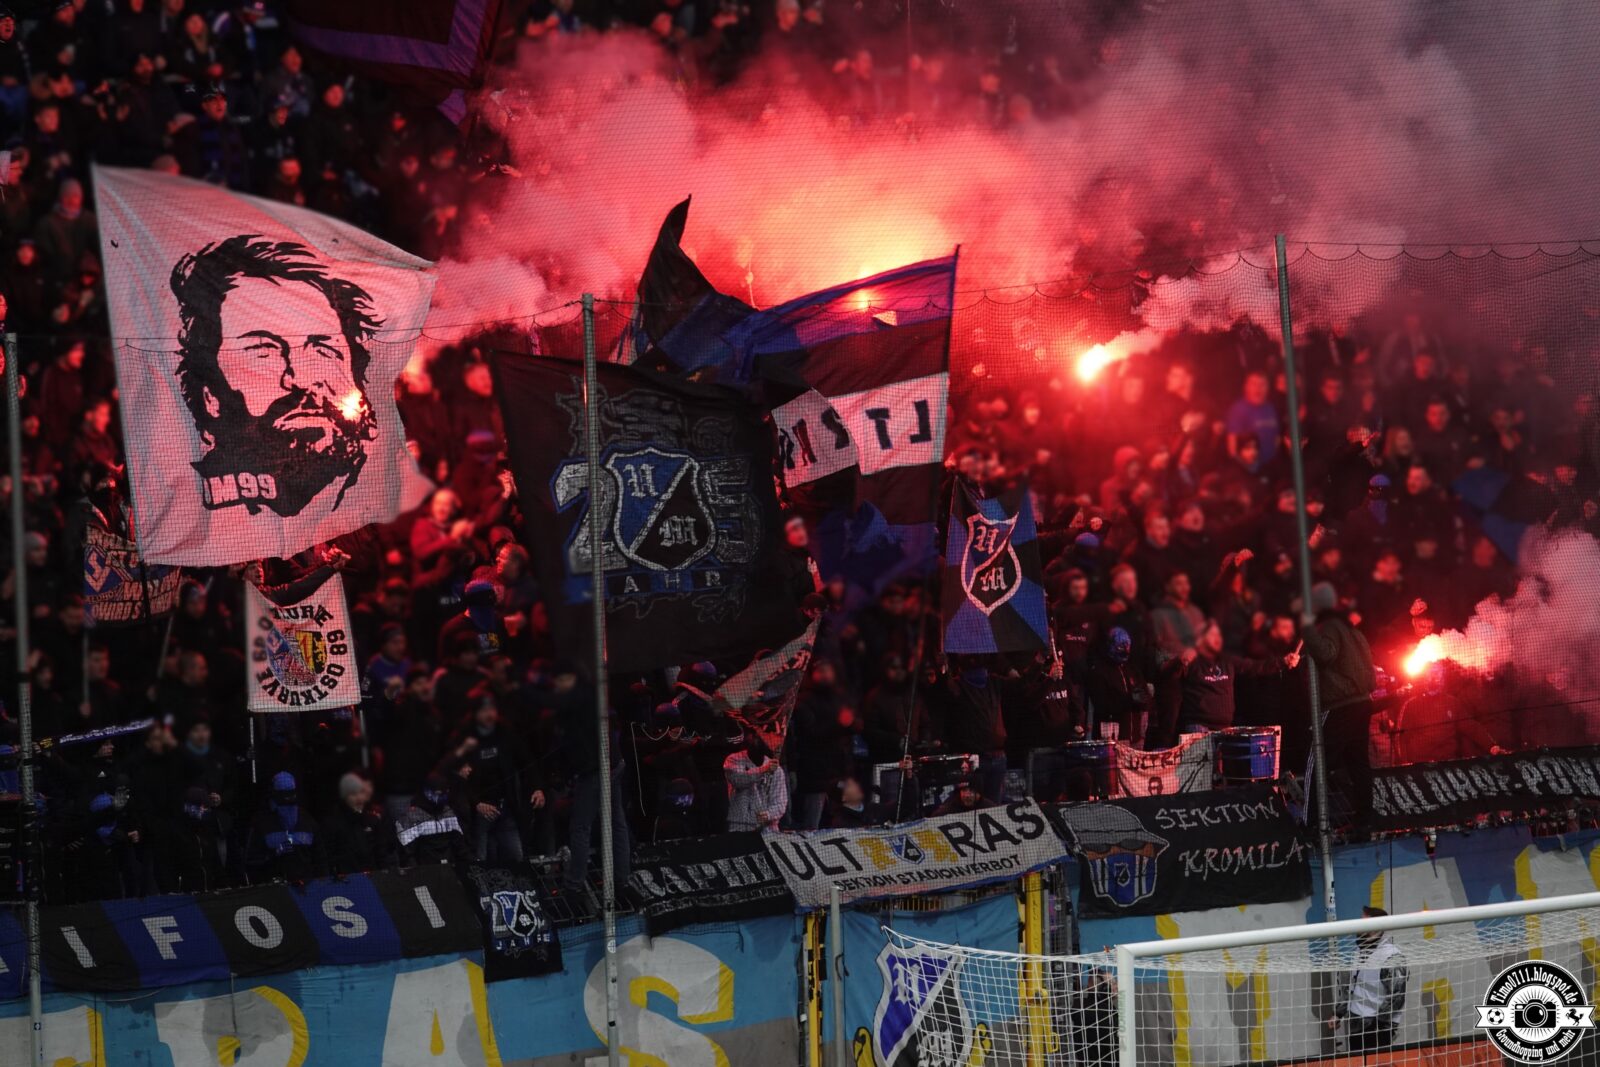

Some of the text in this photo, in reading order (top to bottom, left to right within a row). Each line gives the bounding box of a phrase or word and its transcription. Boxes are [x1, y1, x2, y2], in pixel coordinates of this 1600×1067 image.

[203, 472, 277, 505] M99
[1155, 796, 1280, 830] SEKTION
[0, 884, 446, 974] IFOSI
